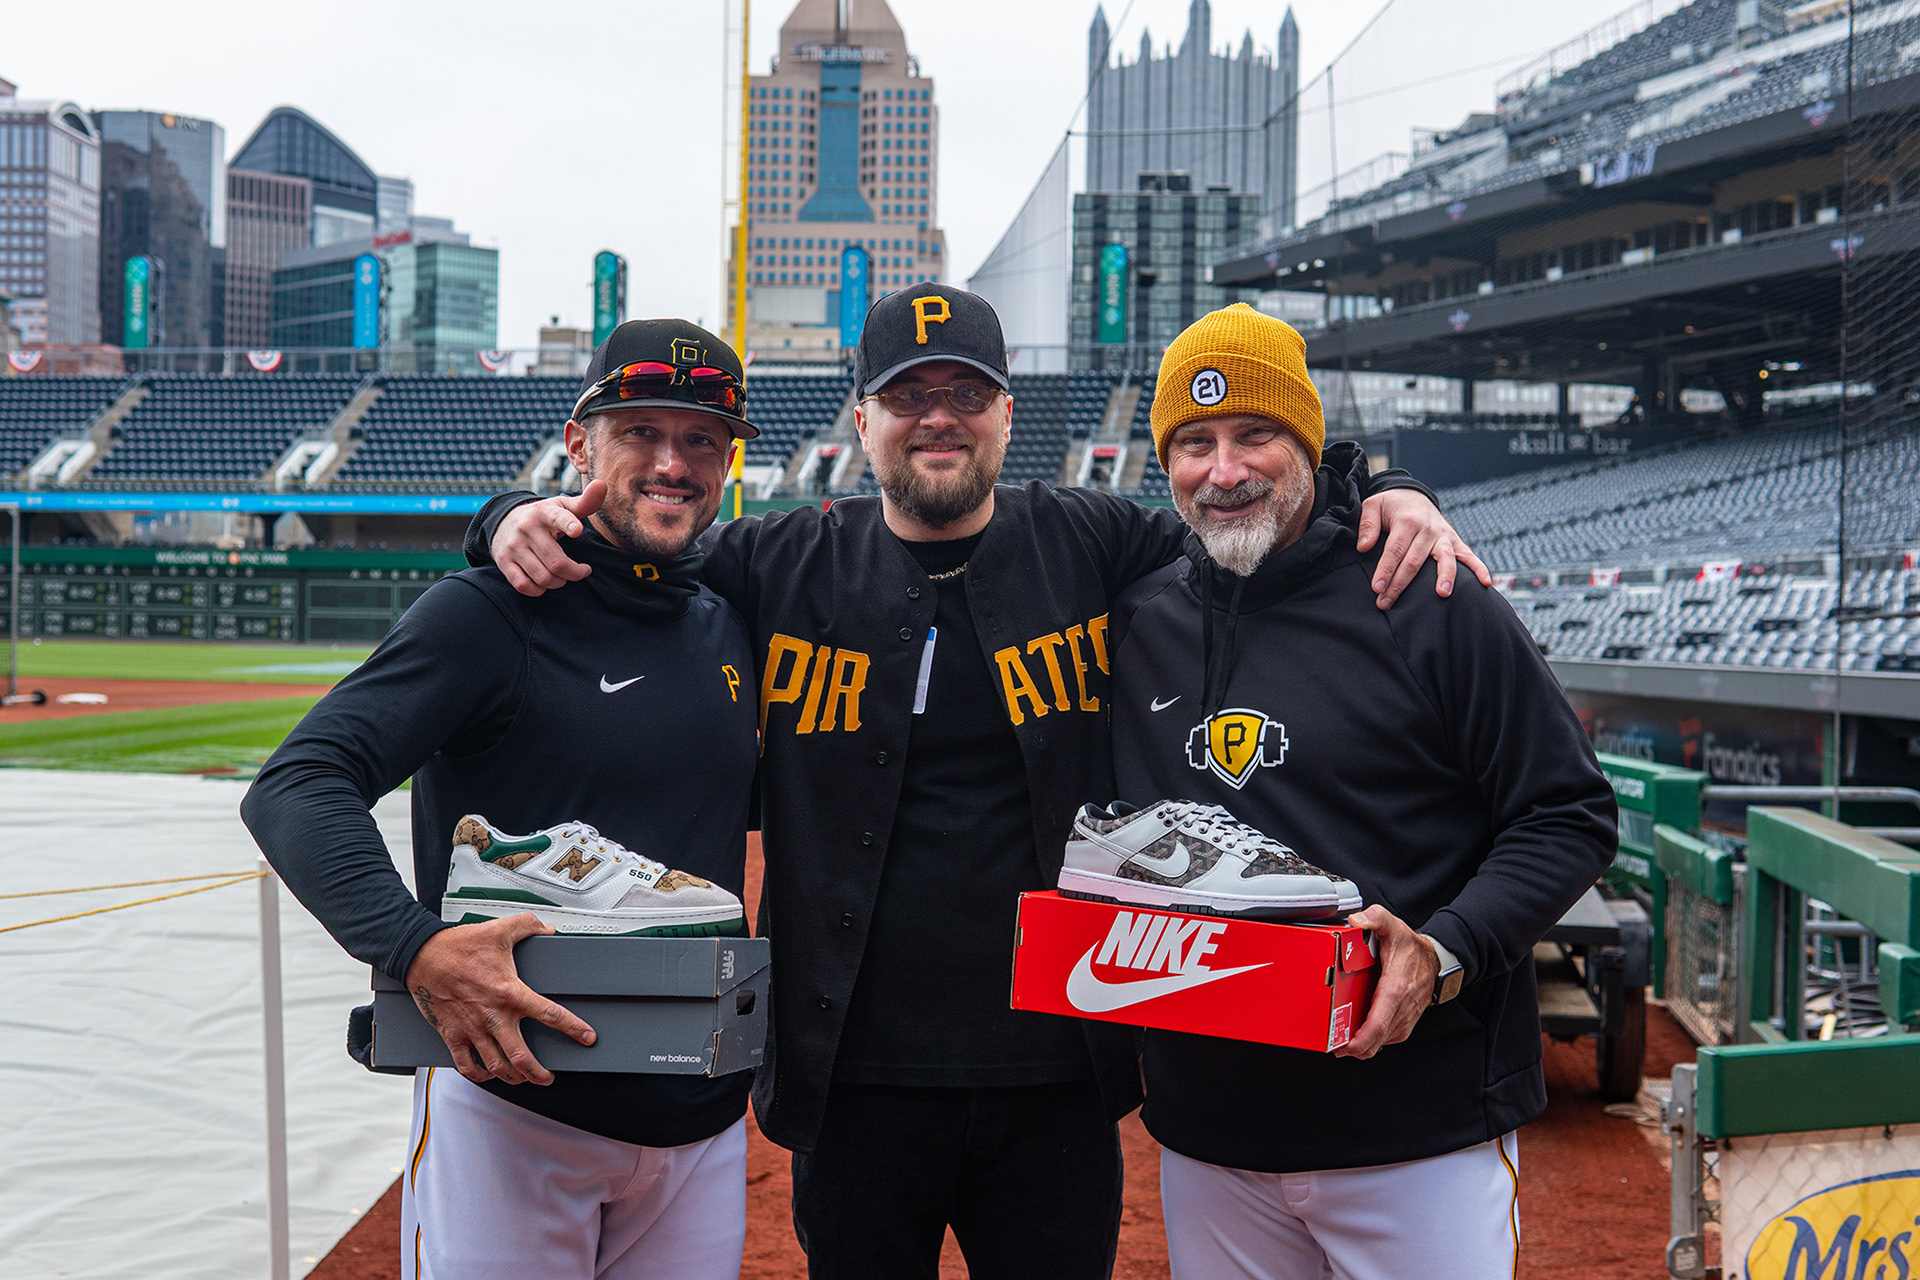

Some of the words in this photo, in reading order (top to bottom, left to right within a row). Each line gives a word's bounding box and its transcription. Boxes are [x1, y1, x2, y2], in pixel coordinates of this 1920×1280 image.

[911, 296, 951, 345] P
[1198, 375, 1220, 399] 21
[1508, 431, 1564, 455] skull
[1593, 431, 1632, 455] bar
[155, 552, 210, 564] WELCOME
[212, 552, 227, 564] TO
[261, 553, 289, 565] PARK
[1224, 722, 1248, 764] P
[1703, 732, 1781, 786] Fanatics
[629, 868, 653, 882] 550
[562, 923, 580, 932] new
[583, 923, 620, 932] balance
[1095, 911, 1228, 975] NIKE
[668, 1054, 701, 1063] balance
